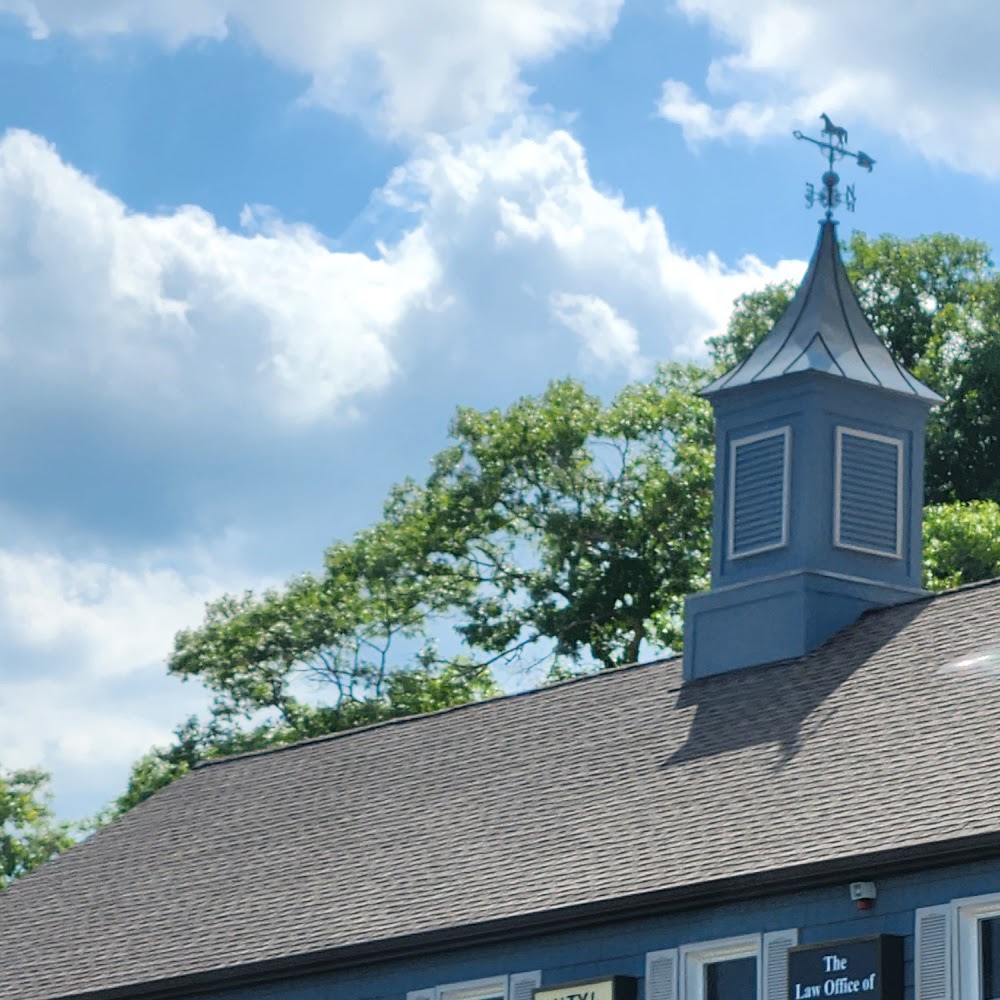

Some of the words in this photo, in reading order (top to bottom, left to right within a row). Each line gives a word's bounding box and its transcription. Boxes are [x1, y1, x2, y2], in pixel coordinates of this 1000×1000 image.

[822, 955, 848, 973] The
[795, 983, 821, 1000] Law
[823, 977, 860, 997] Office
[861, 973, 876, 990] of
